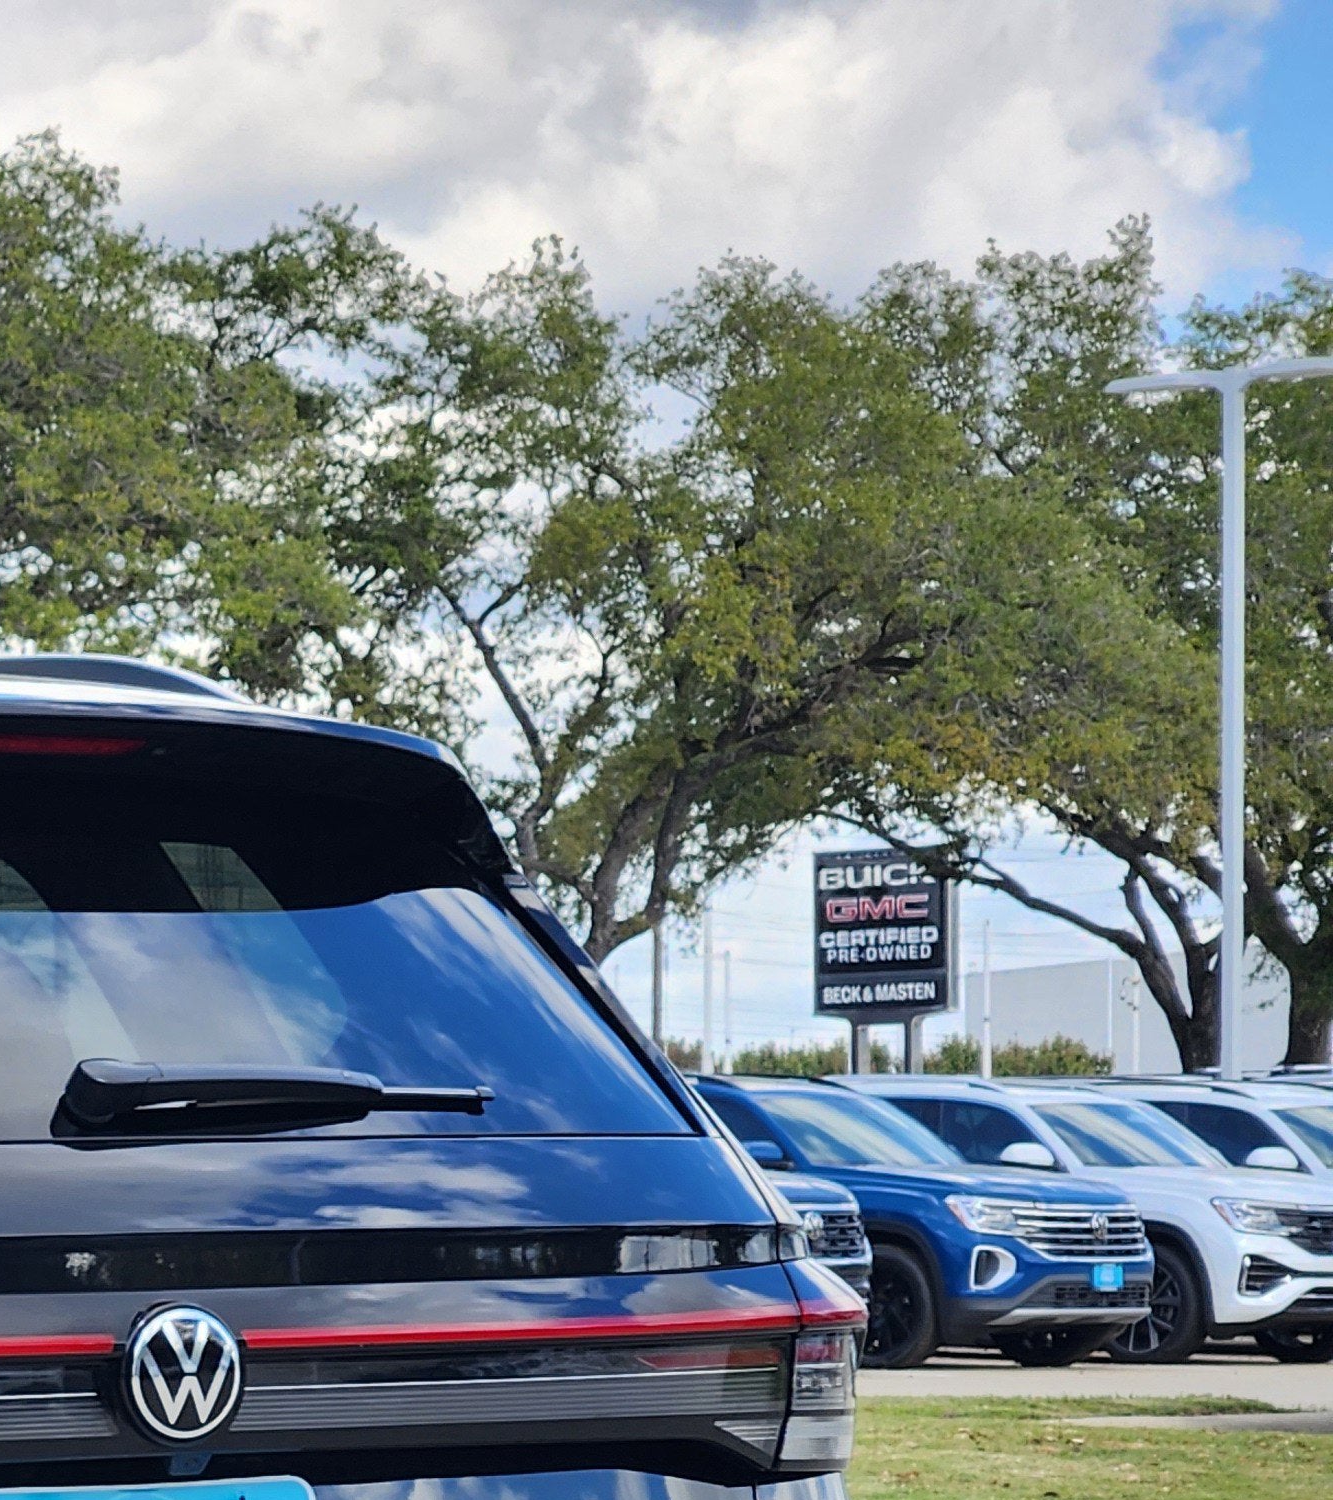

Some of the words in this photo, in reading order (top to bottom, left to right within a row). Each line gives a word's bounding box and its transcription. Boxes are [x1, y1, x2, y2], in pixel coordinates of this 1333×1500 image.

[818, 862, 936, 890] BUICK
[826, 893, 930, 923] GMC
[819, 925, 939, 949] CERTIFIED
[826, 943, 932, 964] PRE-OWNED
[822, 984, 862, 1005] BECK
[862, 984, 874, 1003] &
[875, 981, 936, 1002] MASTEN
